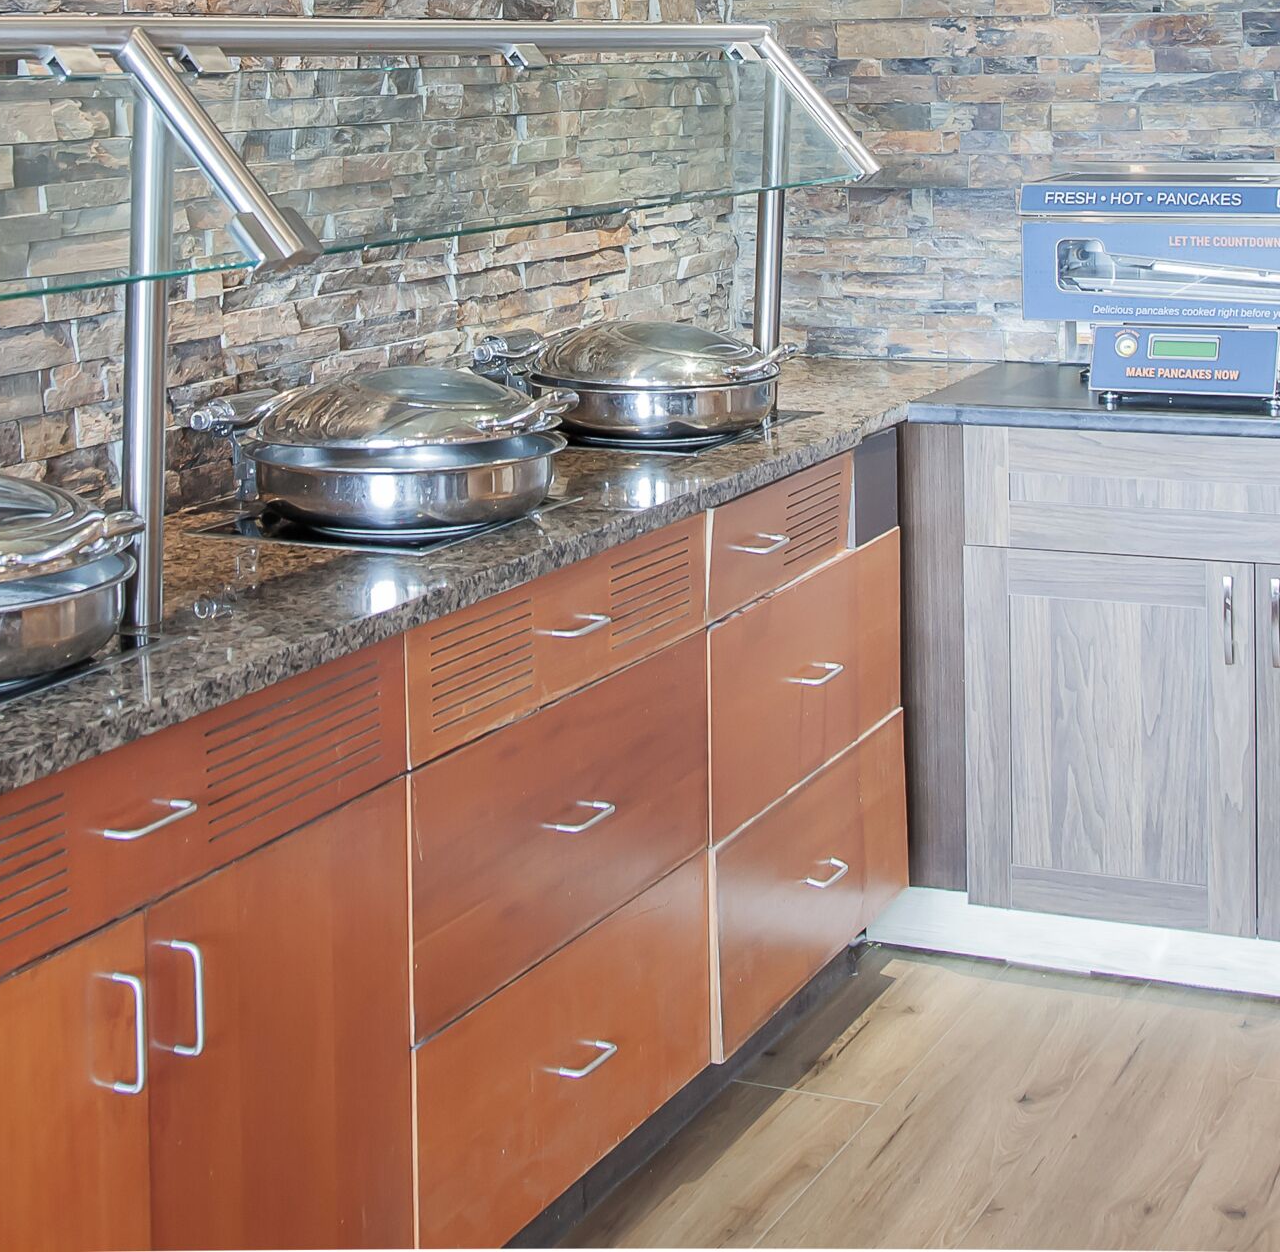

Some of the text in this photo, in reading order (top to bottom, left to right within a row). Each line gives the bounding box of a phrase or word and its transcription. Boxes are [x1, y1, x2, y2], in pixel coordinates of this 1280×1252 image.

[1045, 191, 1242, 206] FRESH HOT PANCAKES
[1169, 235, 1187, 247] LET
[1190, 236, 1210, 247] THE
[1092, 305, 1134, 315] Delicious
[1135, 307, 1180, 317] pancakes
[1182, 307, 1216, 317] cooked
[1217, 308, 1238, 319] right
[1240, 308, 1271, 318] before
[1125, 367, 1240, 380] MAKE PANCAKES NOW
